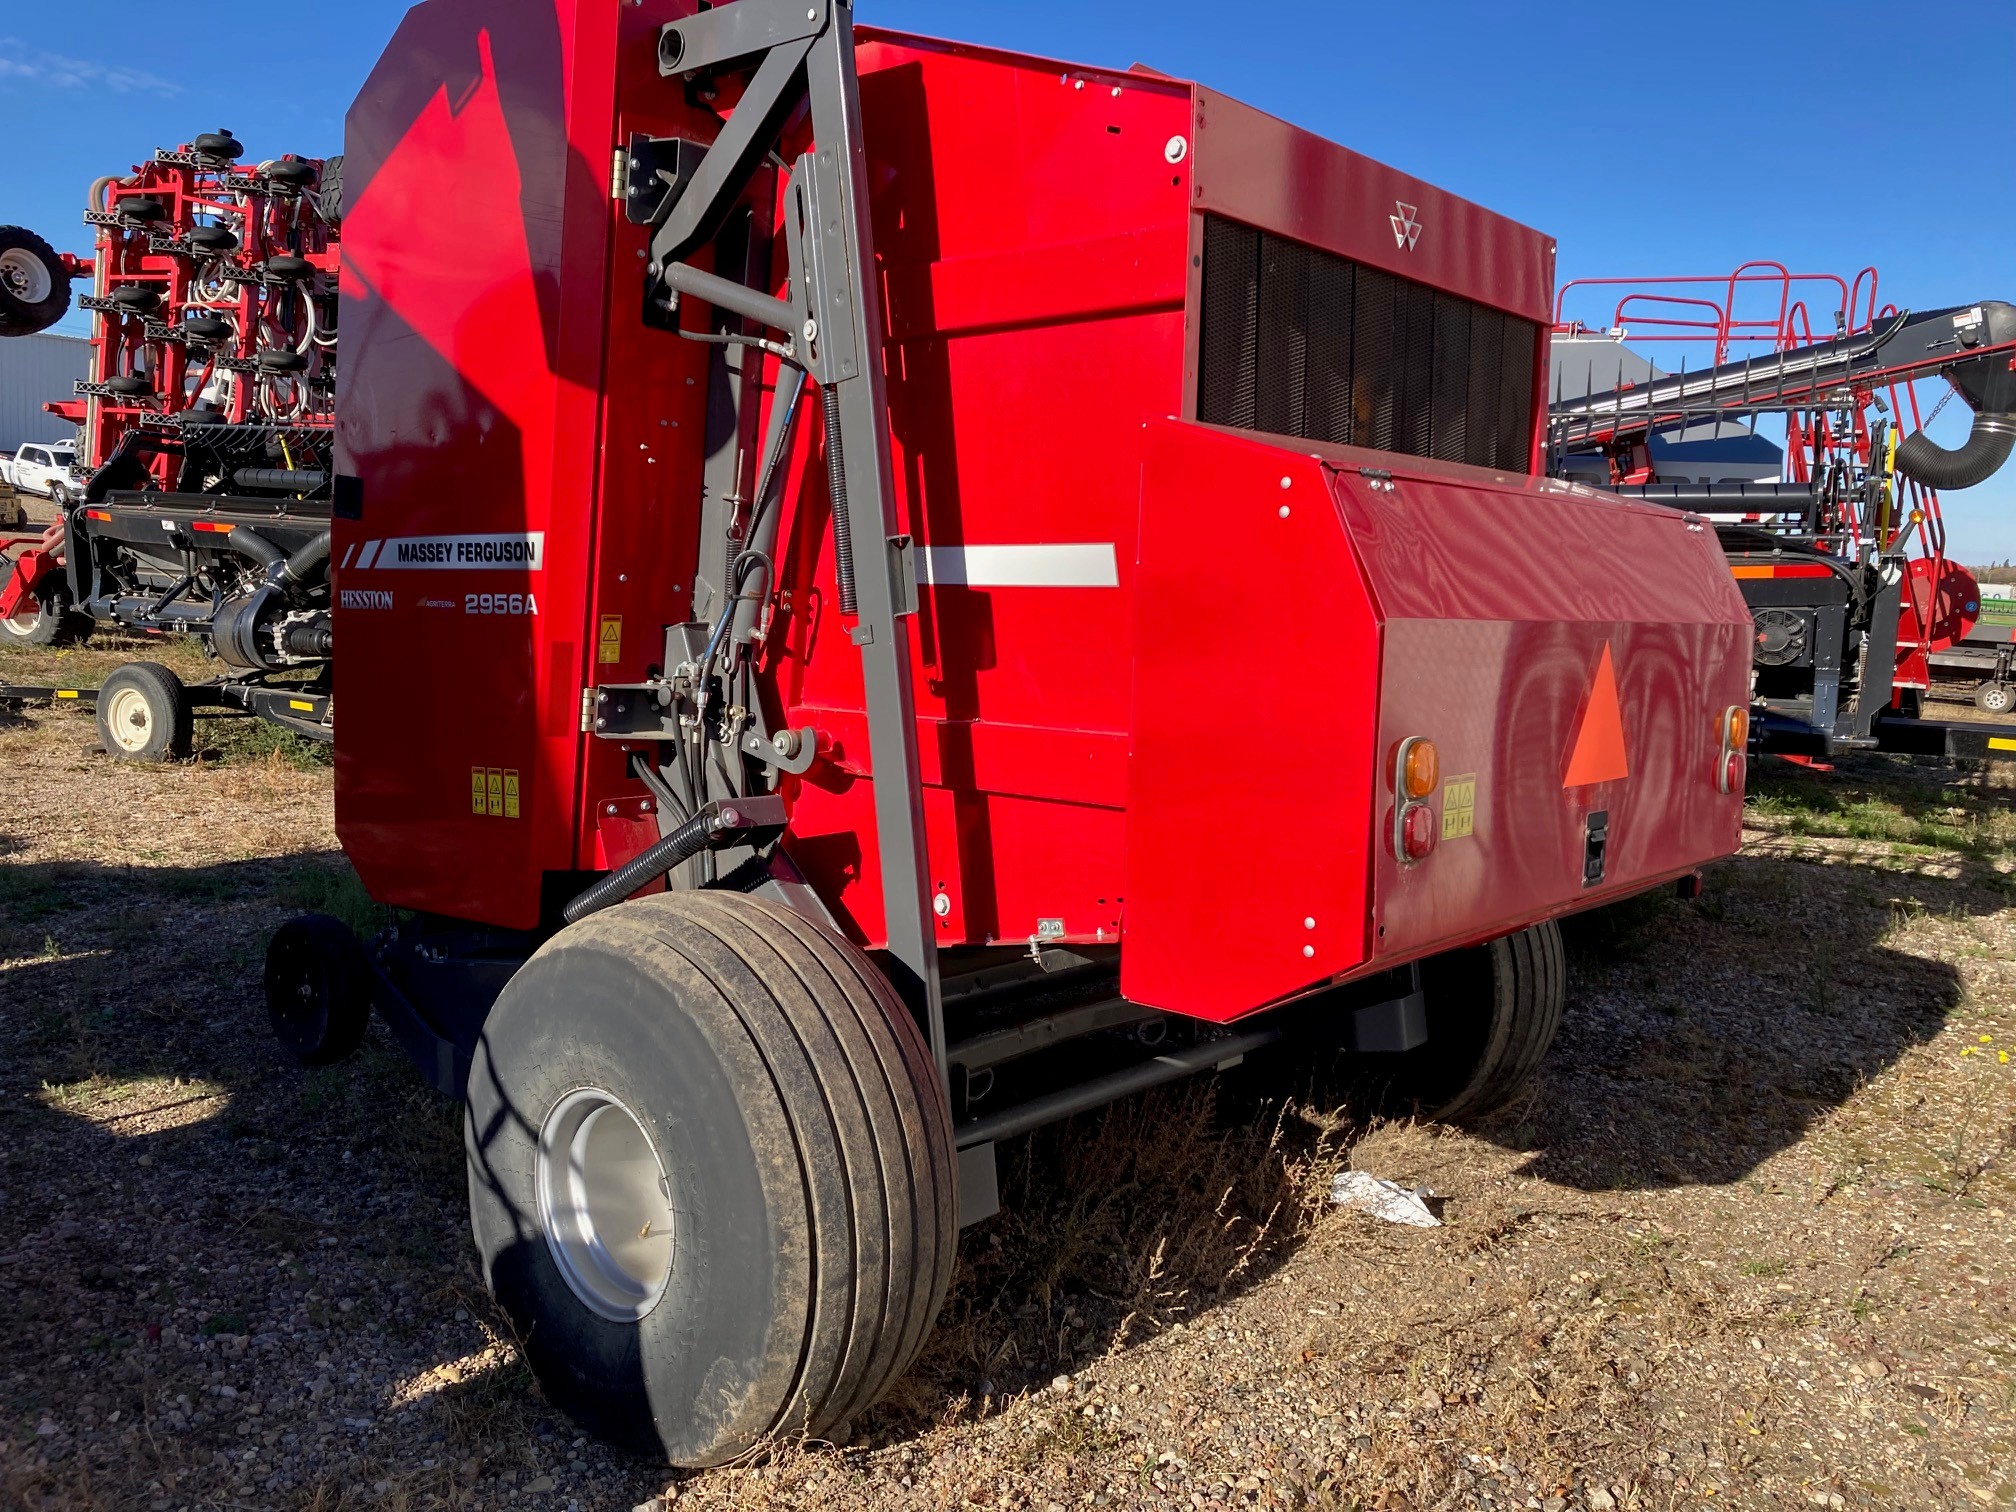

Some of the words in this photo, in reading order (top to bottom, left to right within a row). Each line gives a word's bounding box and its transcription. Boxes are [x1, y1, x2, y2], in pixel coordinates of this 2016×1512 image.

[398, 543, 452, 562] MASSEY
[457, 541, 535, 562] FERGUSON
[340, 590, 394, 610] HESSTON
[426, 600, 456, 608] AGRITERRA
[465, 593, 539, 615] 2956A
